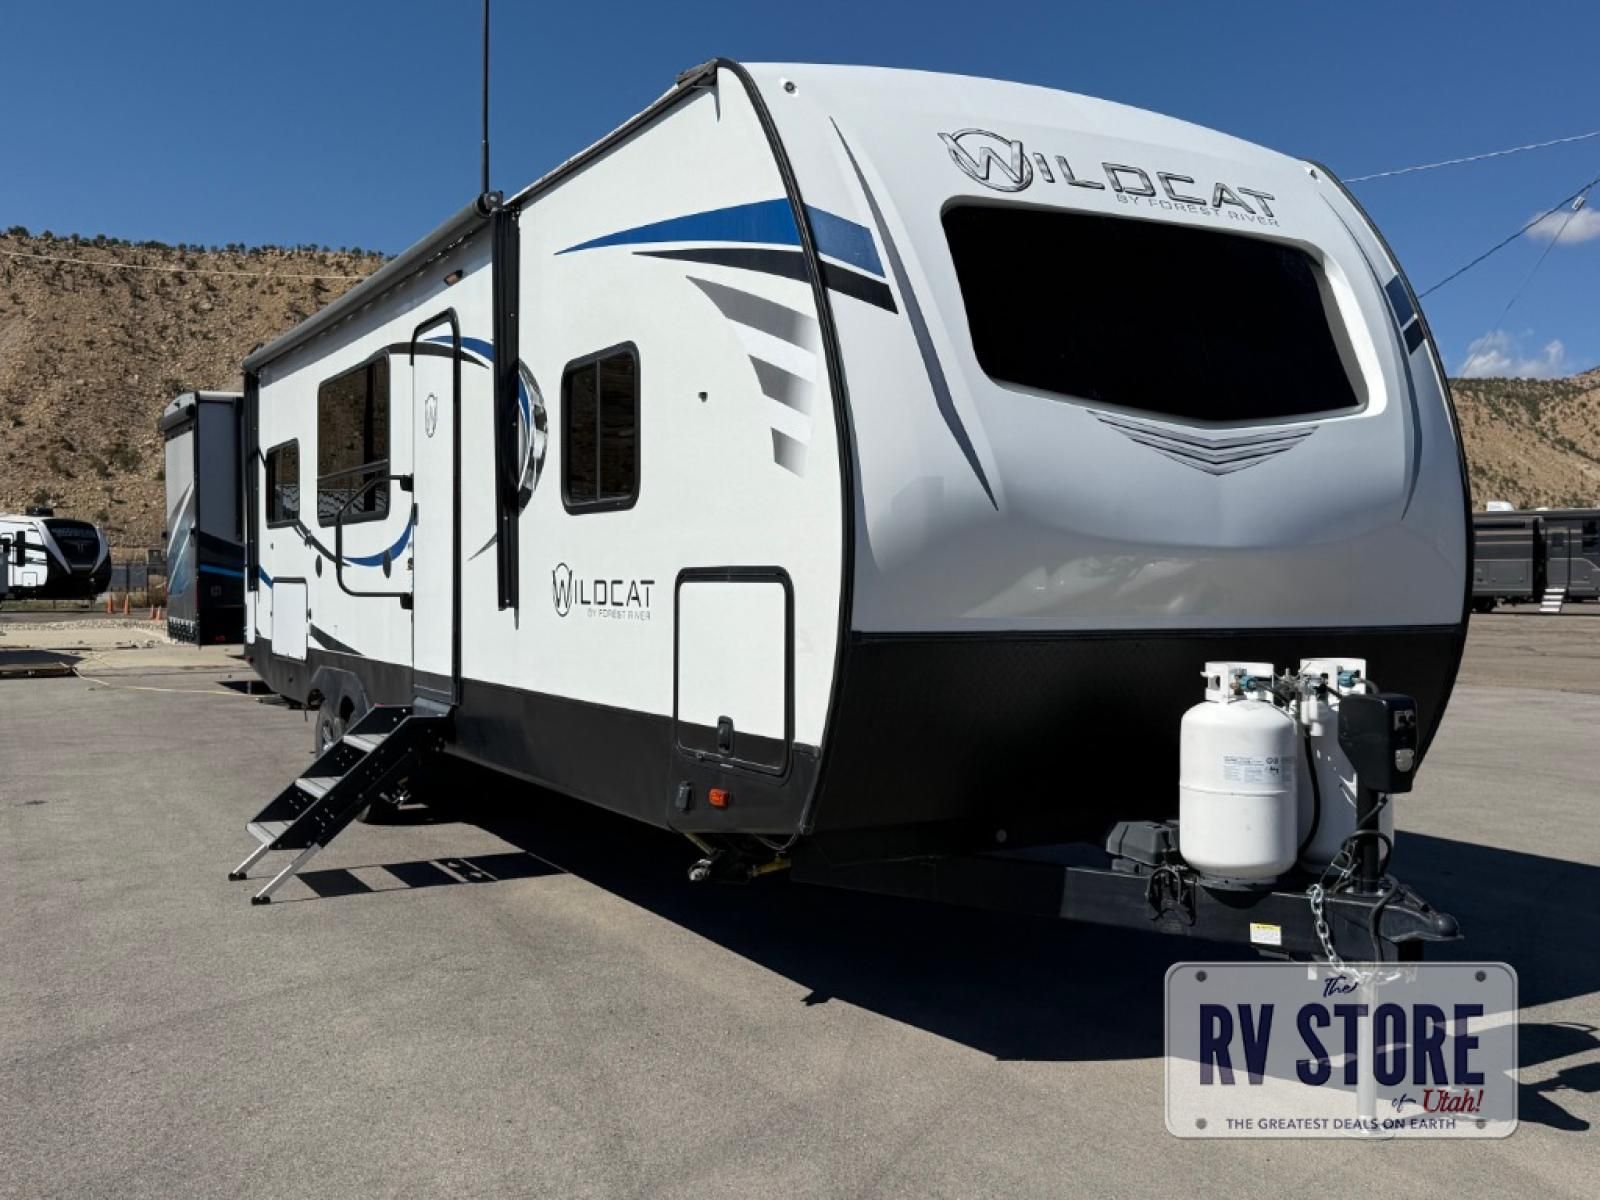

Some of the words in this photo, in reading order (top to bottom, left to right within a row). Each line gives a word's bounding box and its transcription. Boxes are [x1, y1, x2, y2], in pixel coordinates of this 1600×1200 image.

[937, 128, 1277, 218] WILDCAT
[1116, 193, 1139, 206] BY
[1149, 198, 1220, 217] FOREST
[1227, 210, 1281, 228] RIVER
[552, 562, 655, 617] WILDCAT
